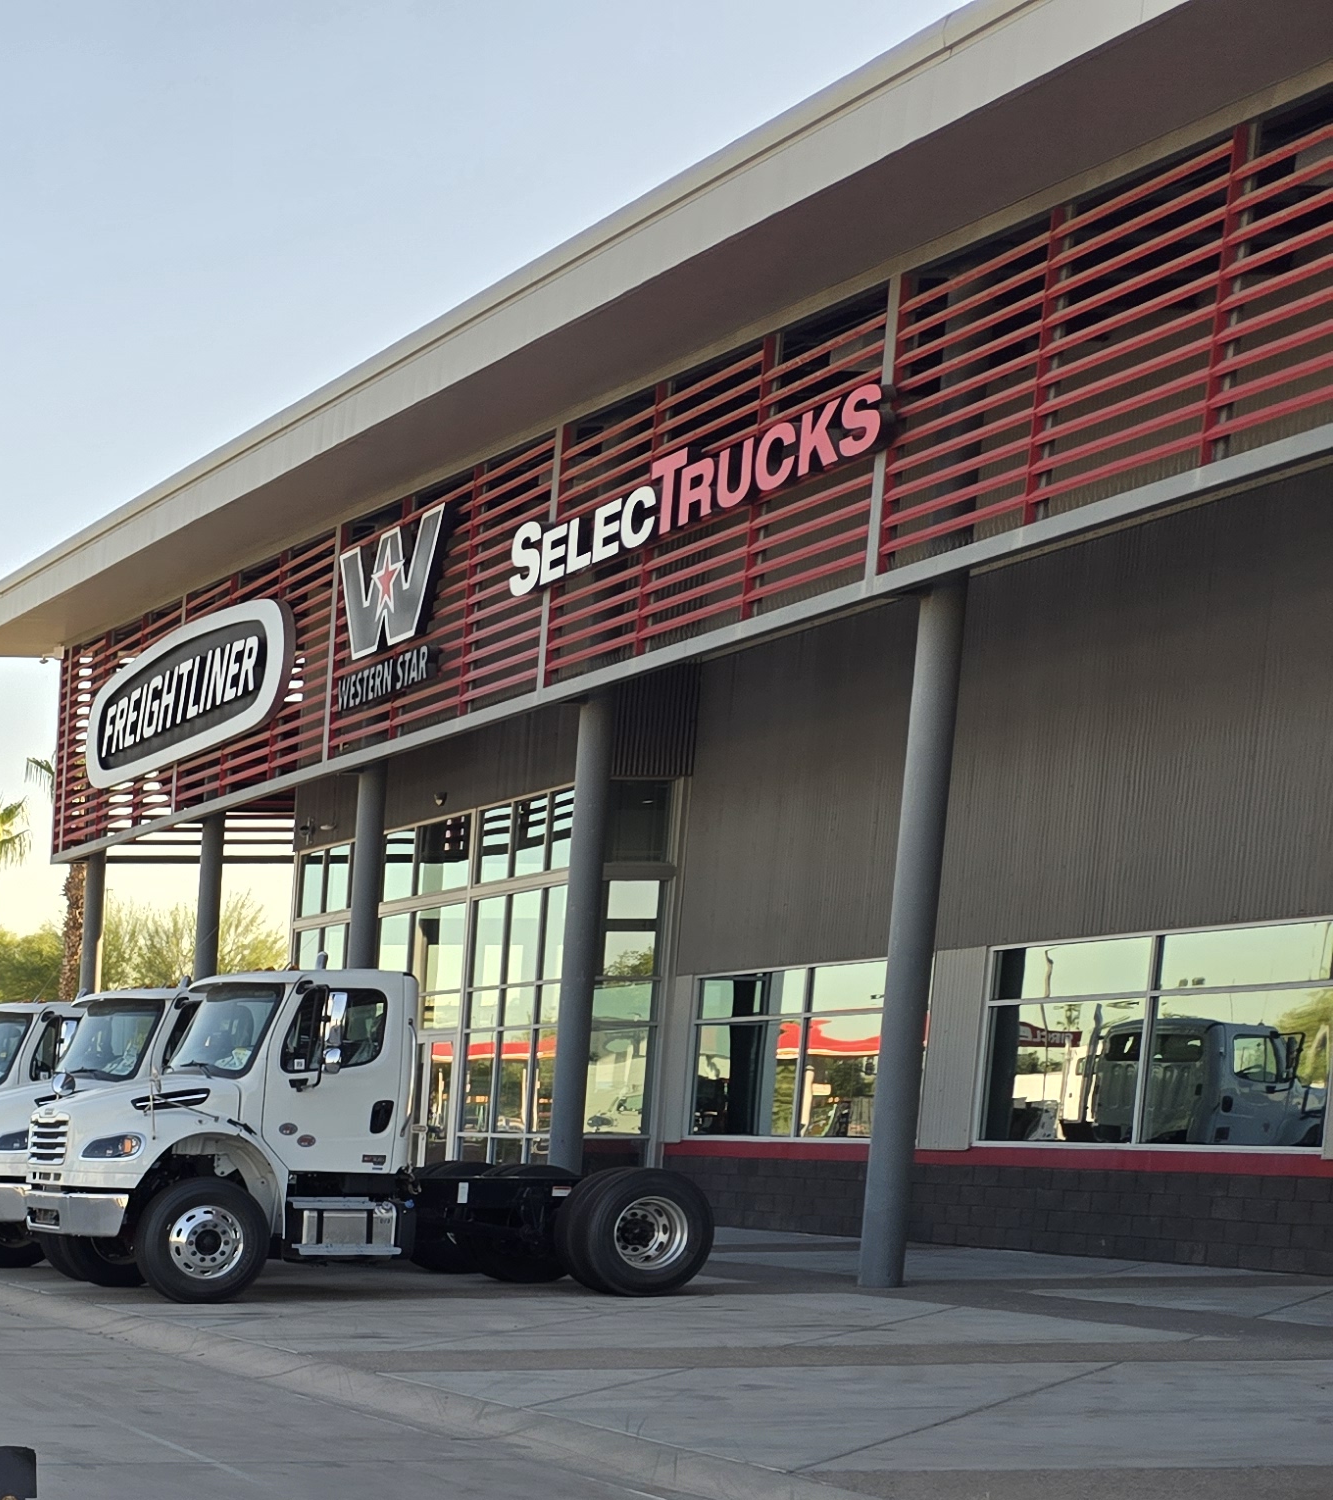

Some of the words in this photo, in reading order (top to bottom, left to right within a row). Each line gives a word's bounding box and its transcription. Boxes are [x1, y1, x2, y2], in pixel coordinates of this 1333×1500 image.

[100, 635, 259, 758] FREIGHTLINER
[337, 659, 393, 711] WESTERN
[395, 645, 429, 691] STAR
